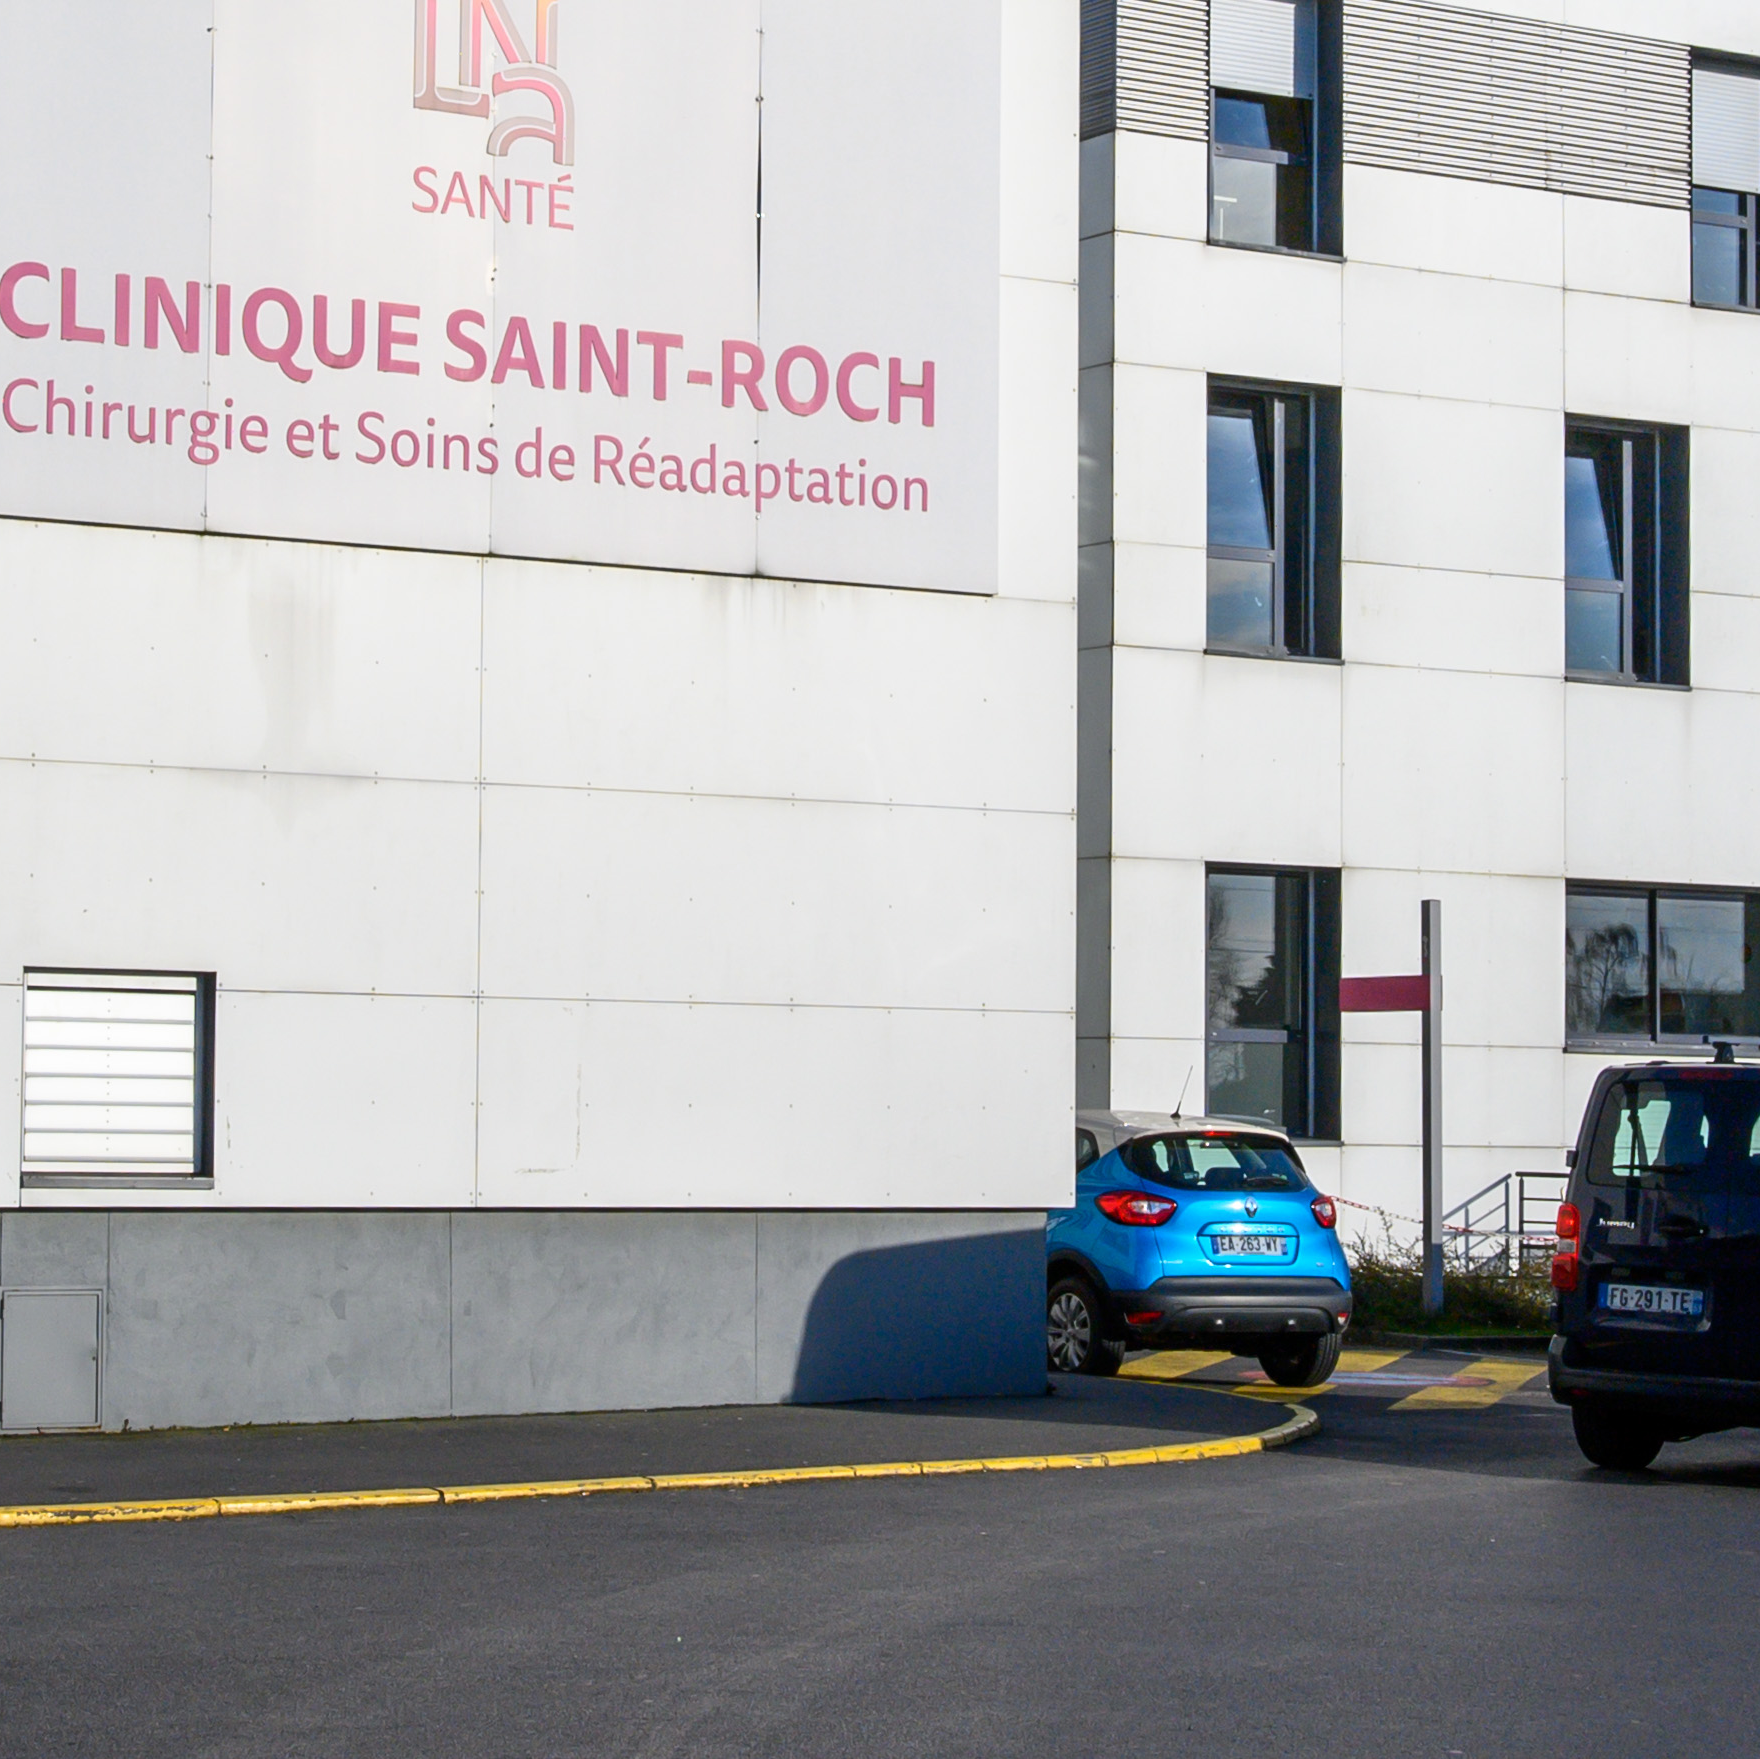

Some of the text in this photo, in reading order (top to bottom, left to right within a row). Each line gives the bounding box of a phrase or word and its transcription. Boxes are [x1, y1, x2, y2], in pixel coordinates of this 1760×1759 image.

[412, 166, 574, 231] SANTÉ
[443, 308, 935, 427] SAINT-ROCH
[2, 377, 929, 513] Chirurgie et Soins de Réadaptation
[1609, 1287, 1691, 1311] FG-291-TE
